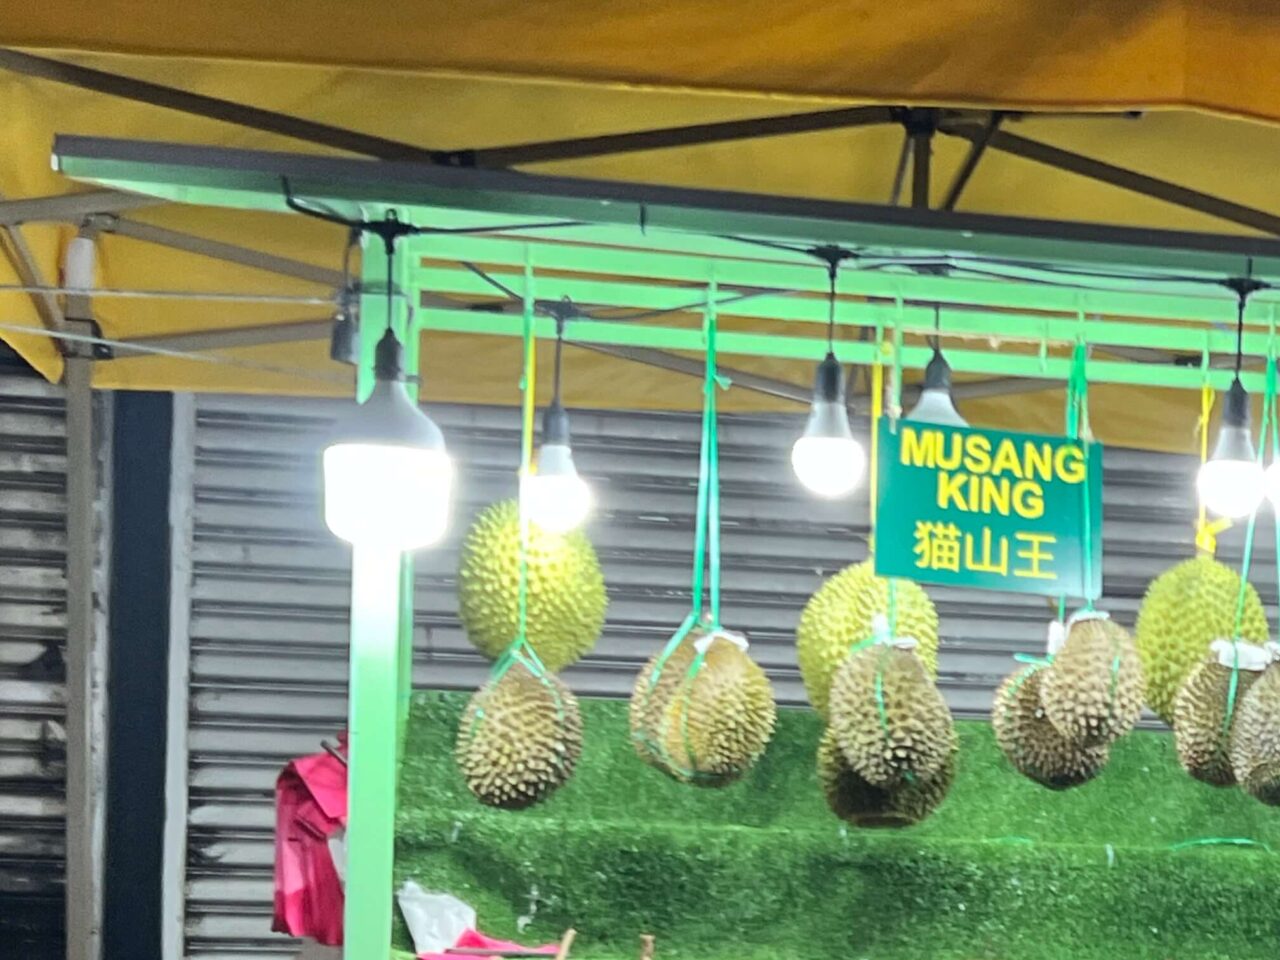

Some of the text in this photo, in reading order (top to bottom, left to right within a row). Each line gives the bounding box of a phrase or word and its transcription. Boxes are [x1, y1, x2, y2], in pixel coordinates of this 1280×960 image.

[901, 427, 1087, 484] MUSANG
[937, 470, 1044, 519] KING
[913, 520, 1058, 579] 猫山王
